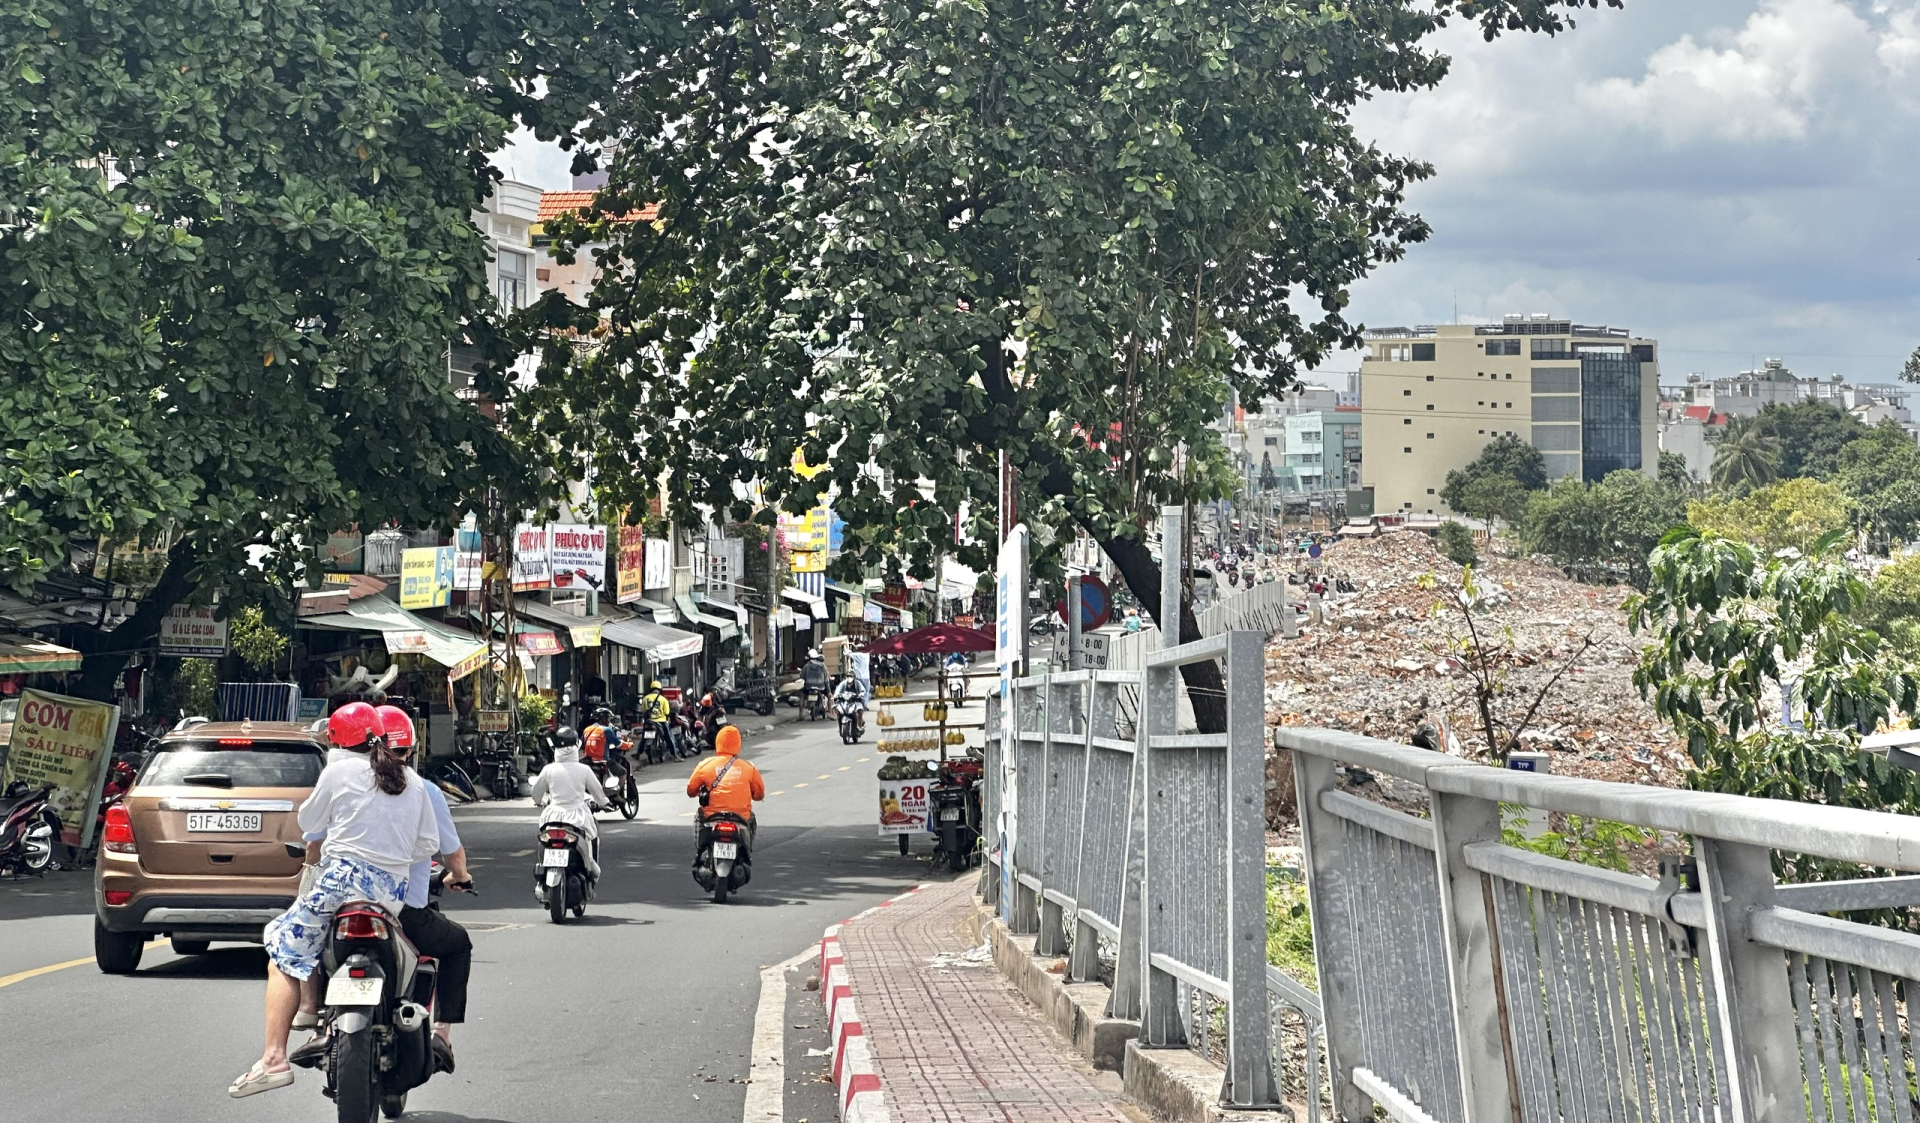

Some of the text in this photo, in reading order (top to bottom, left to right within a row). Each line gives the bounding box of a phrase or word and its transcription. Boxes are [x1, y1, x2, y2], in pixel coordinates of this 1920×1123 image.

[554, 528, 580, 550] PHÚC
[581, 533, 590, 551] &
[590, 530, 605, 551] VŨ
[1085, 638, 1103, 649] 8:00
[1084, 654, 1106, 665] 18:00
[23, 700, 74, 732] CƠM
[18, 724, 39, 736] Quán
[25, 736, 97, 761] SÁU LIÊM
[901, 785, 925, 800] 20
[190, 815, 258, 829] 51F-453.69
